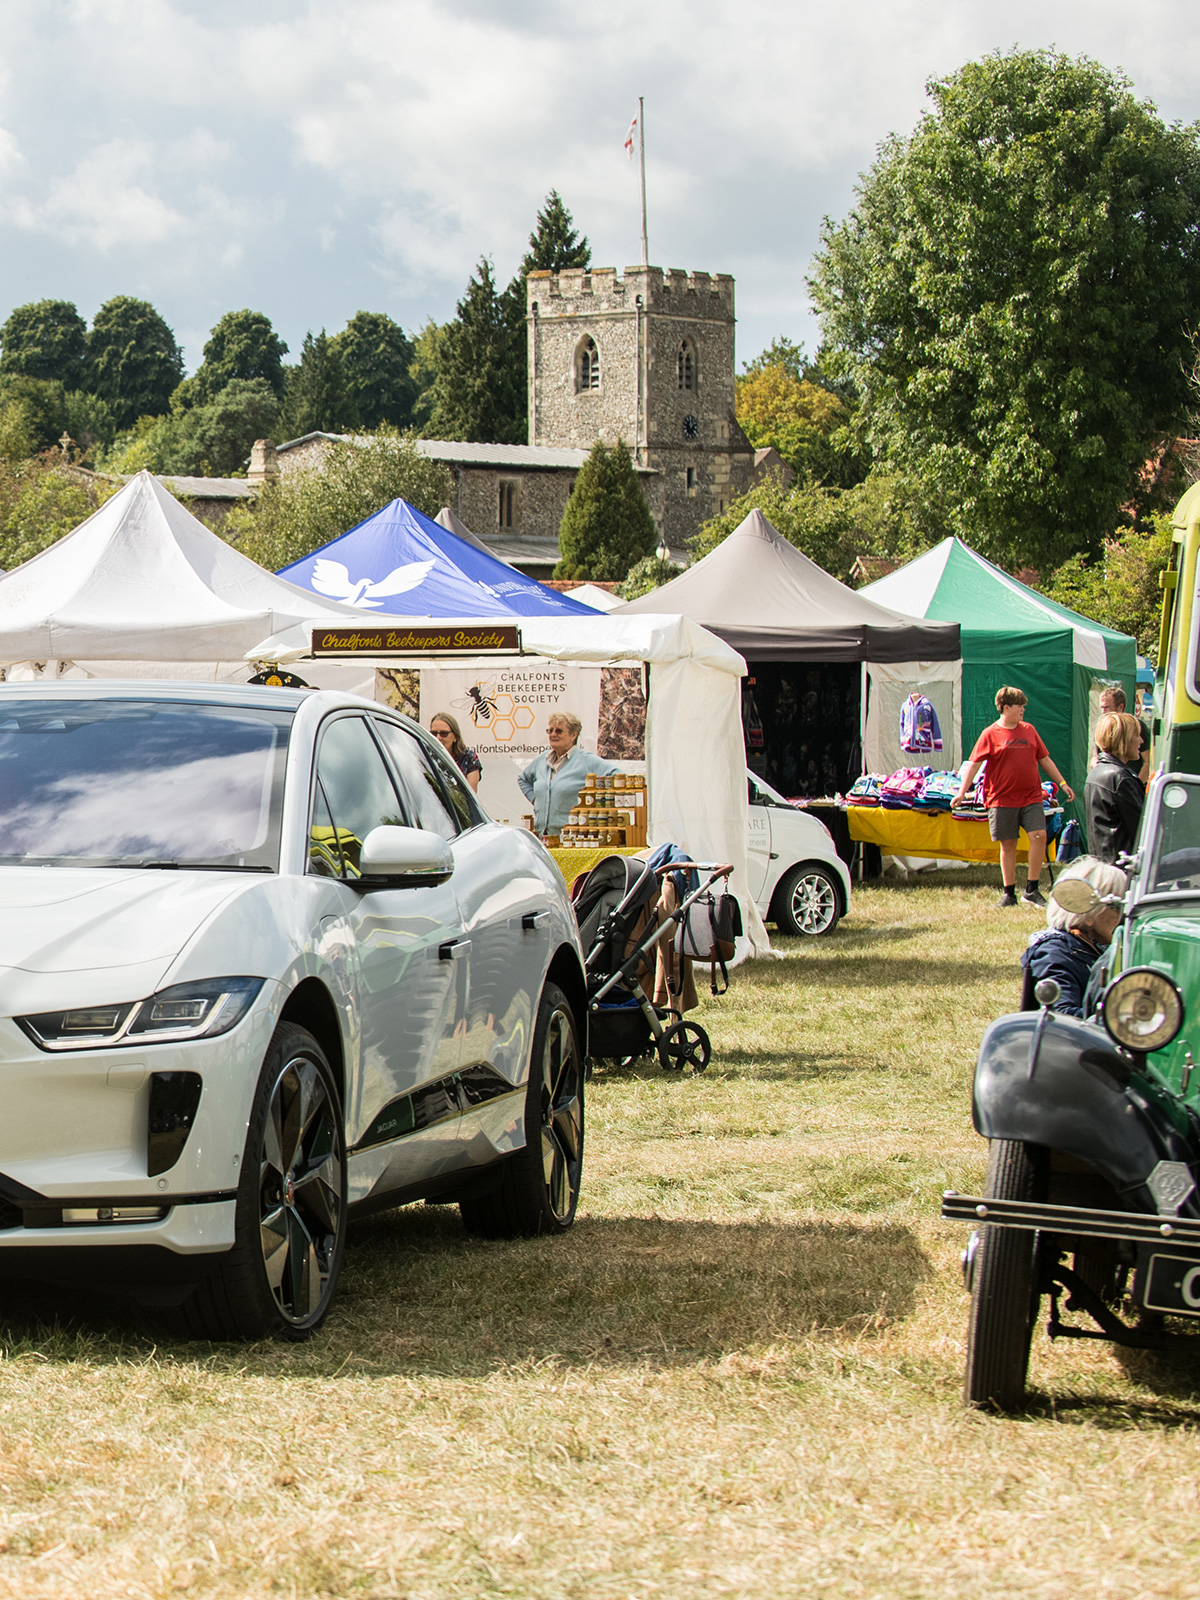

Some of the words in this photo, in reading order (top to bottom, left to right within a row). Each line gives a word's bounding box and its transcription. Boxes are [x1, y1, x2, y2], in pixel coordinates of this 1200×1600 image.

[321, 633, 382, 650] Chalfonts
[386, 631, 451, 649] Beekeepers
[453, 631, 505, 648] Society
[500, 672, 565, 682] CHALFONTS
[514, 694, 560, 703] SOCIETY
